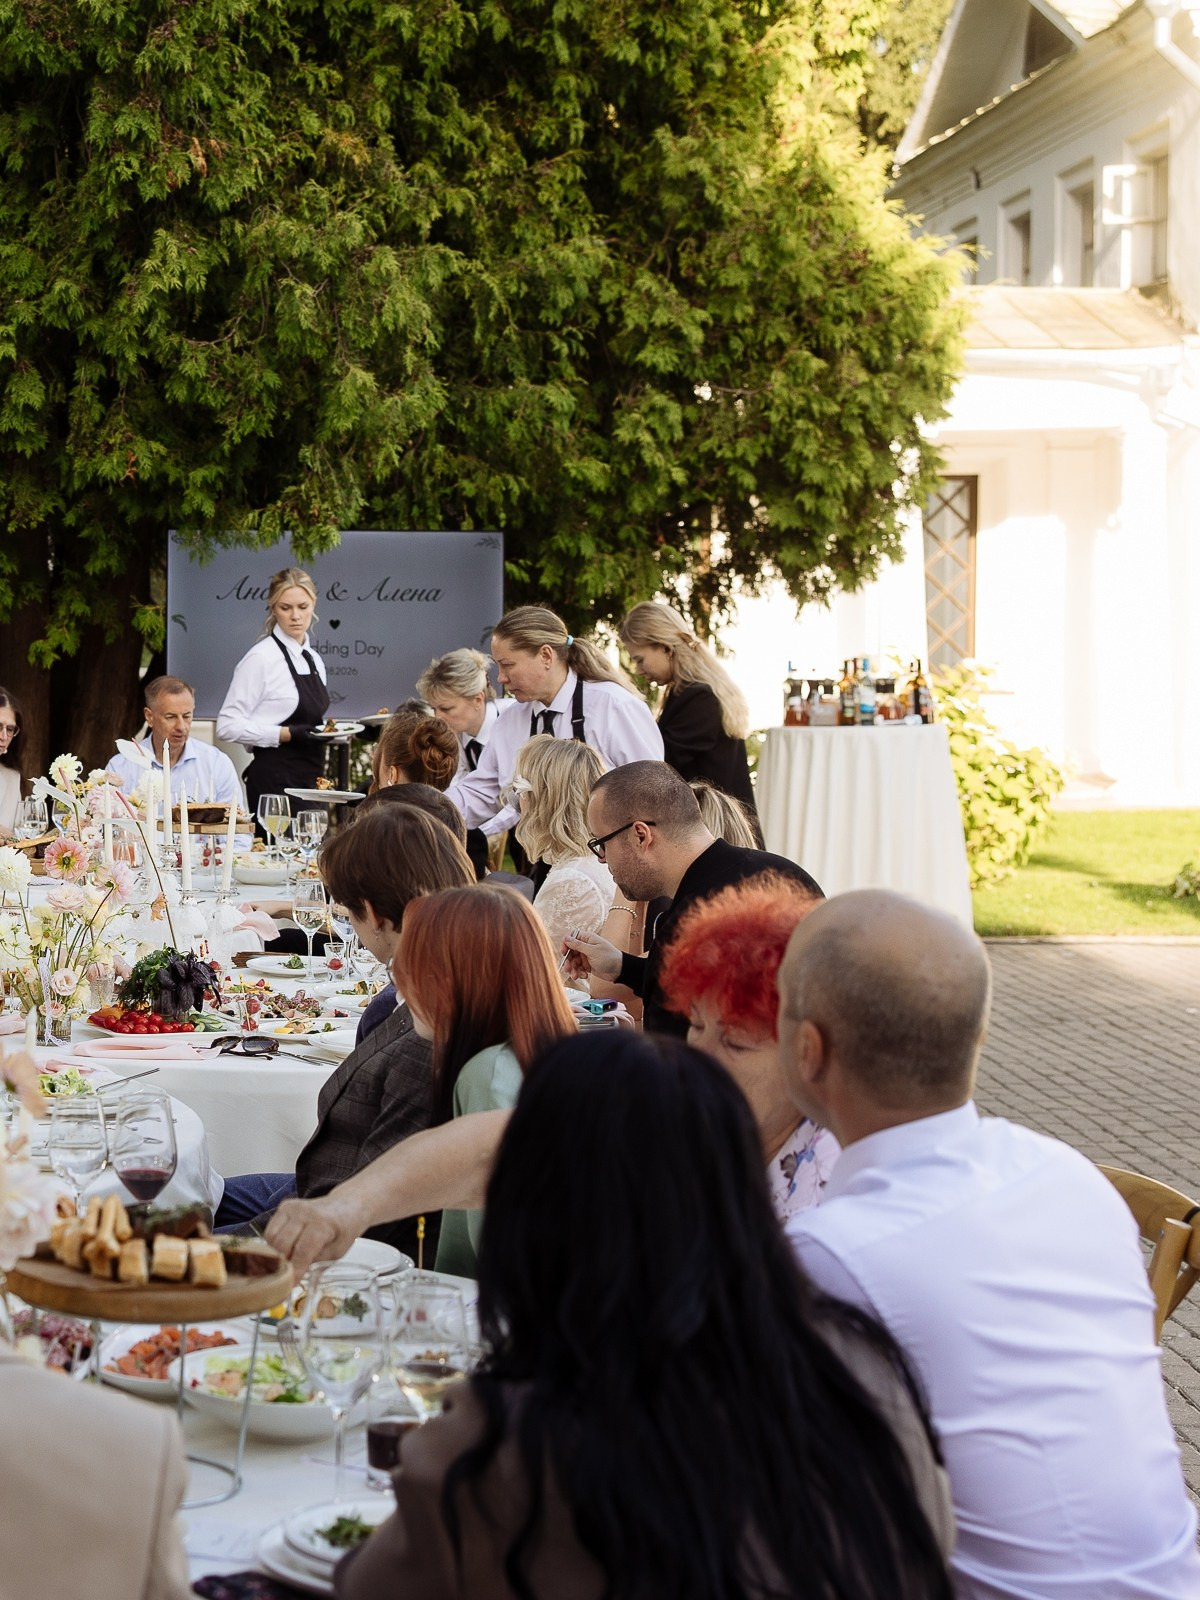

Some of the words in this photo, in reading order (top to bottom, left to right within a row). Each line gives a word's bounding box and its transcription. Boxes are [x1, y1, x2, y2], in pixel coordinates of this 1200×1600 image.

[326, 581, 350, 602] &
[357, 576, 444, 602] Алена
[355, 640, 385, 658] Day
